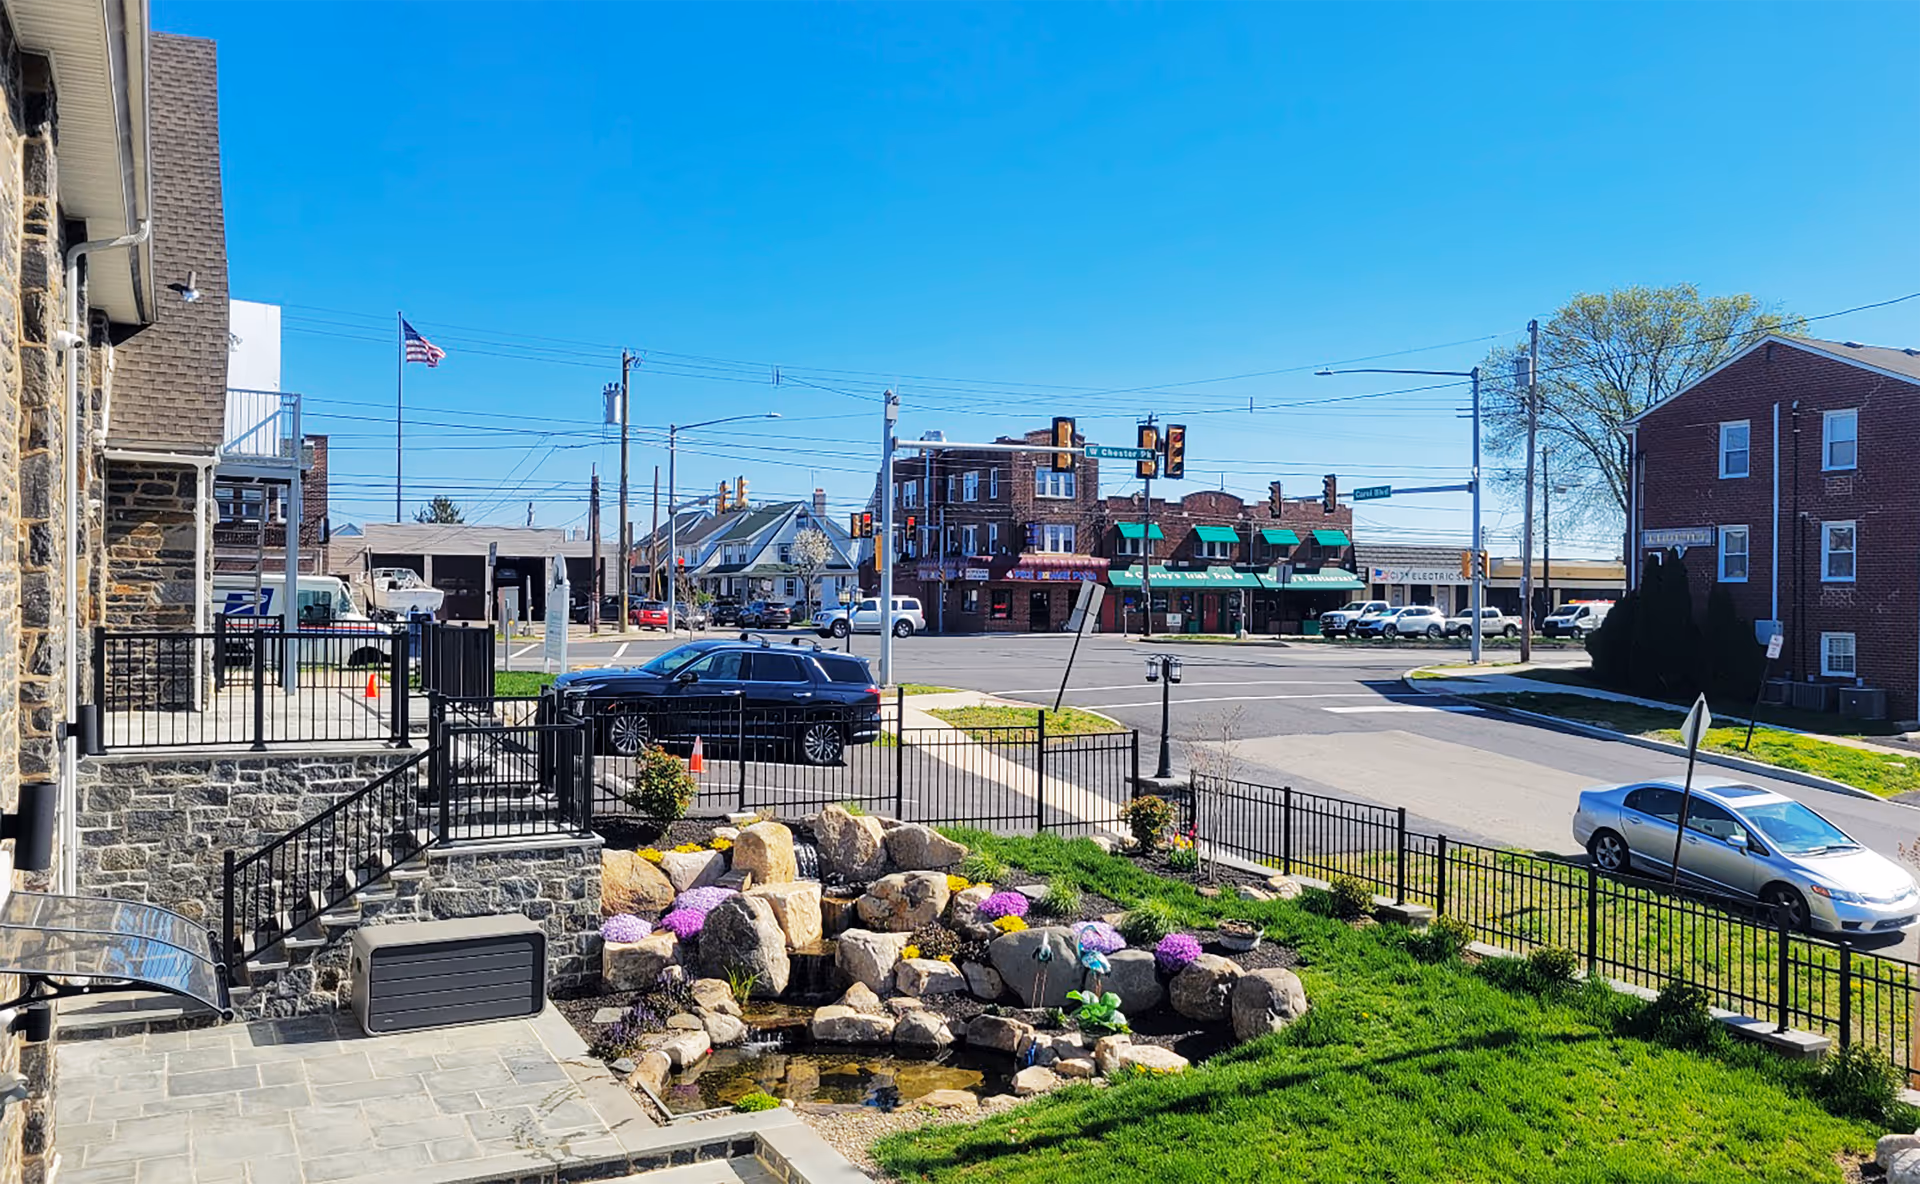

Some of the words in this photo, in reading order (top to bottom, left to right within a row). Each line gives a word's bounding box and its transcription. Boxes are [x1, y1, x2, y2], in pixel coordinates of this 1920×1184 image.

[1089, 447, 1098, 456] W
[1101, 448, 1138, 458] Chester
[1135, 571, 1181, 580] Cwley's
[1212, 572, 1233, 580] Pub
[1412, 571, 1454, 581] ELECTRIC
